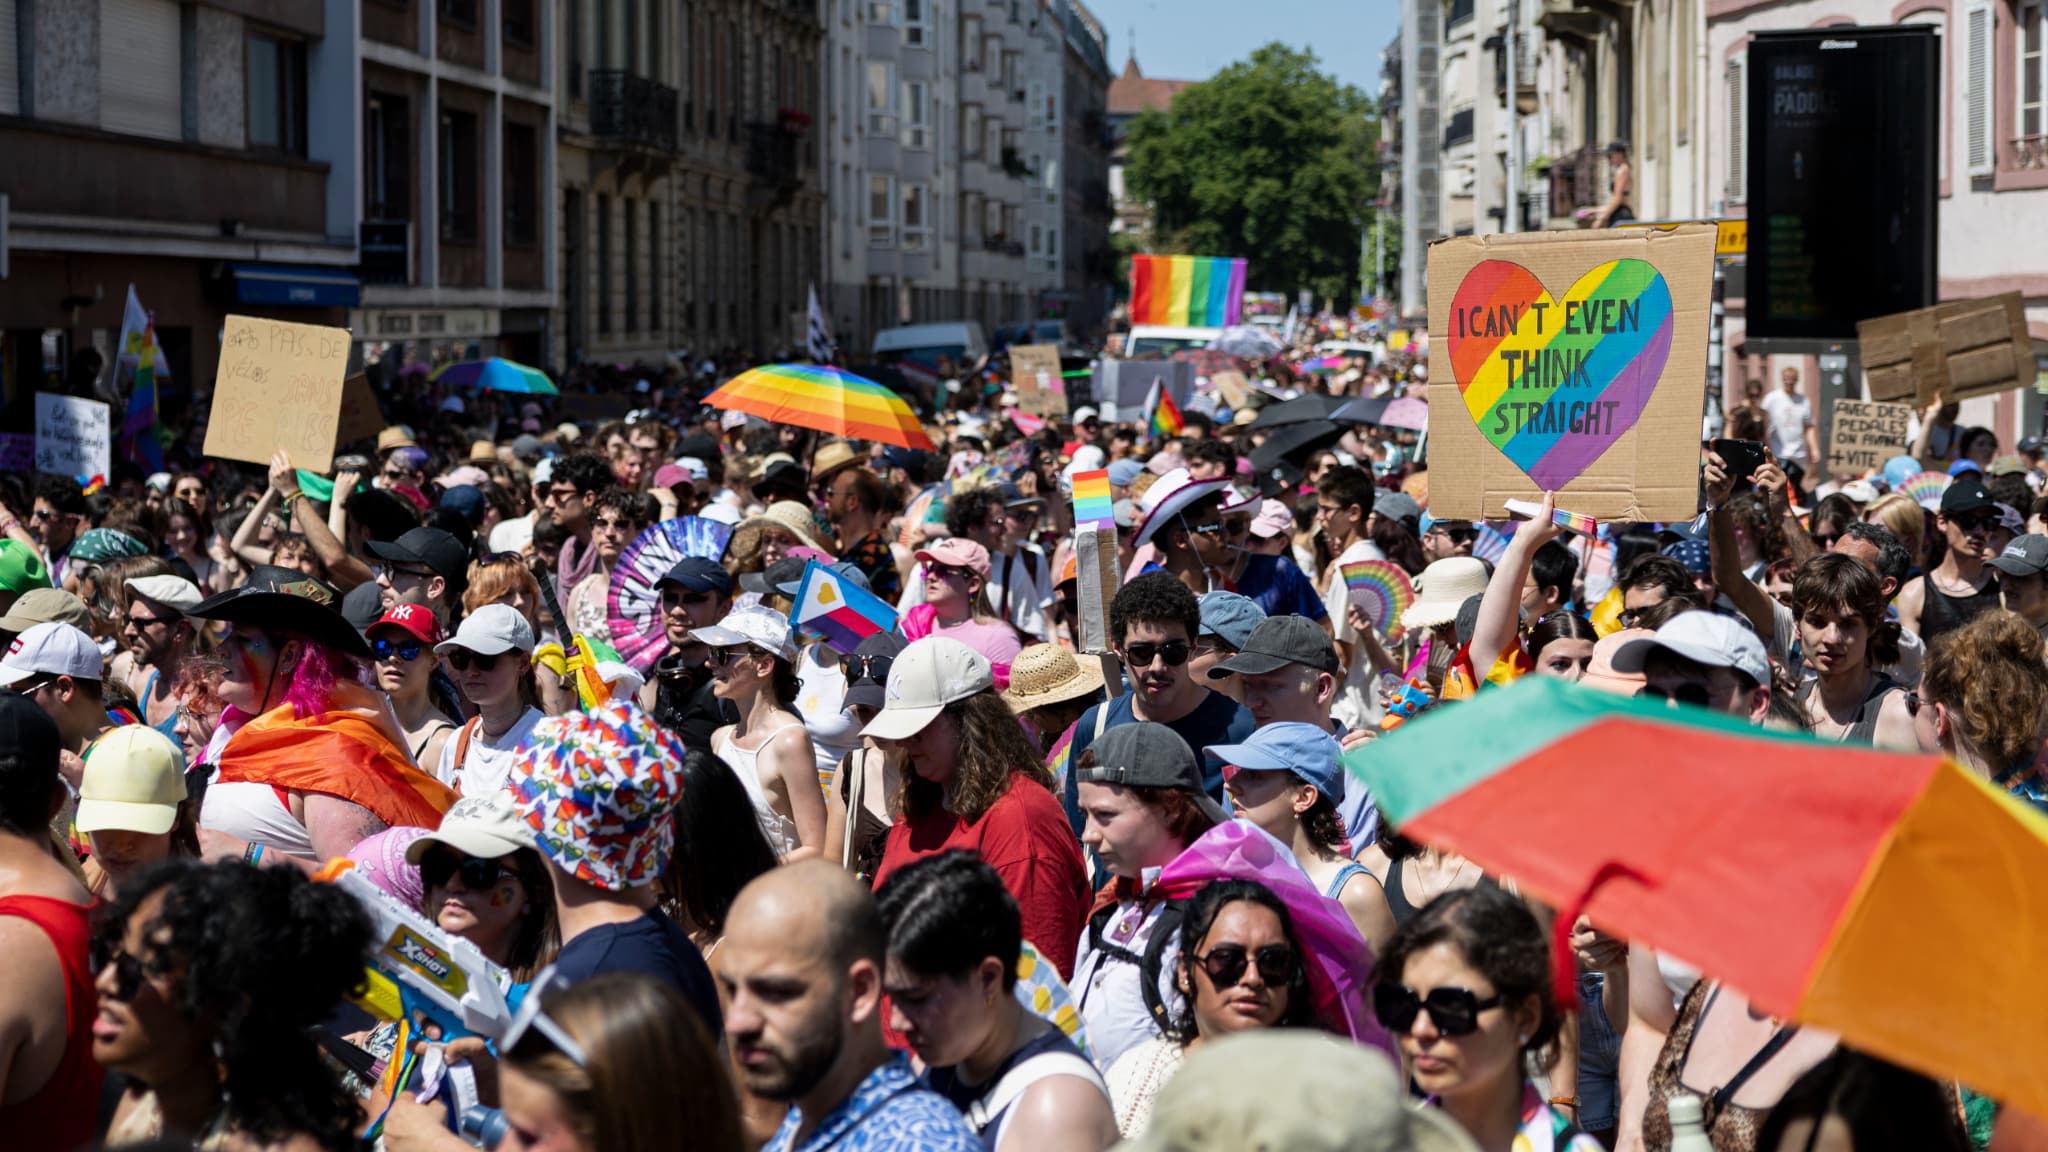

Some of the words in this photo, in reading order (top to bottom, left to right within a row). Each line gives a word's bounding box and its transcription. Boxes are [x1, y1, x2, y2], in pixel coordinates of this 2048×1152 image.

[1458, 307, 1465, 338] I
[1565, 298, 1640, 335] EVEN
[319, 337, 344, 359] DE
[1500, 348, 1593, 389] THINK
[1493, 401, 1620, 435] STRAIGHT
[1836, 402, 1872, 416] AVEC
[1877, 405, 1908, 419] DES
[1837, 432, 1858, 444] ON
[391, 604, 414, 620] NY
